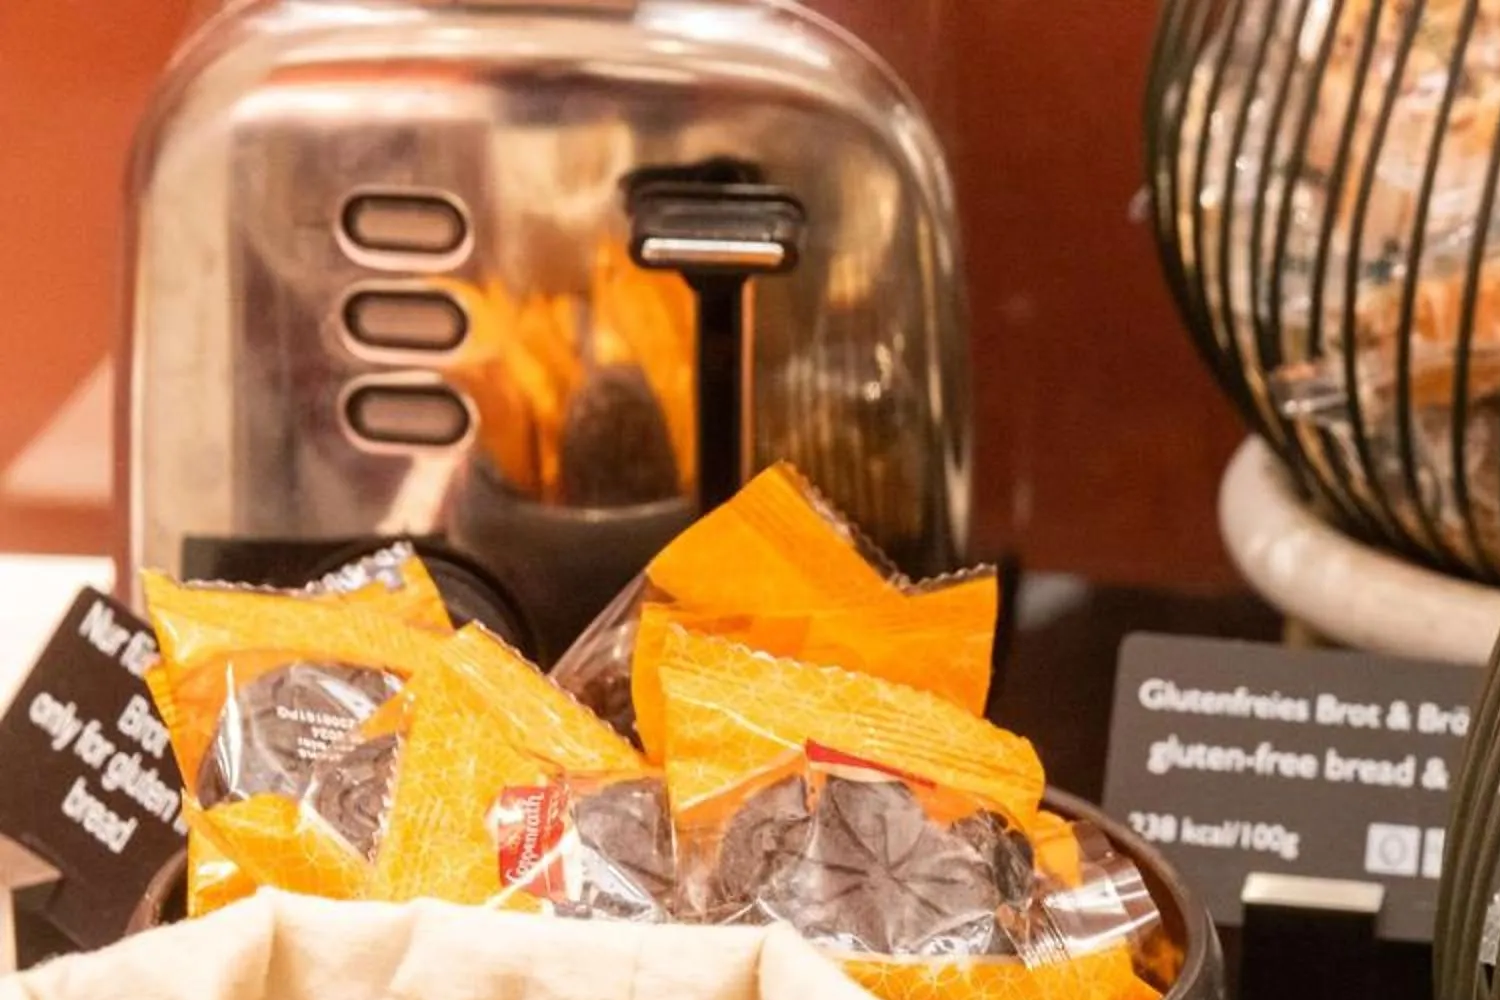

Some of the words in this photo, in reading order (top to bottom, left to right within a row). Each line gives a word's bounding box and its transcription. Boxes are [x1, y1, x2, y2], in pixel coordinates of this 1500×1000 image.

[78, 600, 131, 657] Nur
[1137, 677, 1309, 722] Glutenfreies
[1316, 693, 1383, 730] Brot
[1386, 699, 1412, 733] &
[28, 691, 83, 751] only
[73, 719, 116, 770] for
[101, 752, 180, 824] gluten
[1147, 733, 1319, 780] gluten-free
[1325, 747, 1417, 788] bread
[1421, 756, 1451, 791] &
[60, 775, 138, 854] bread
